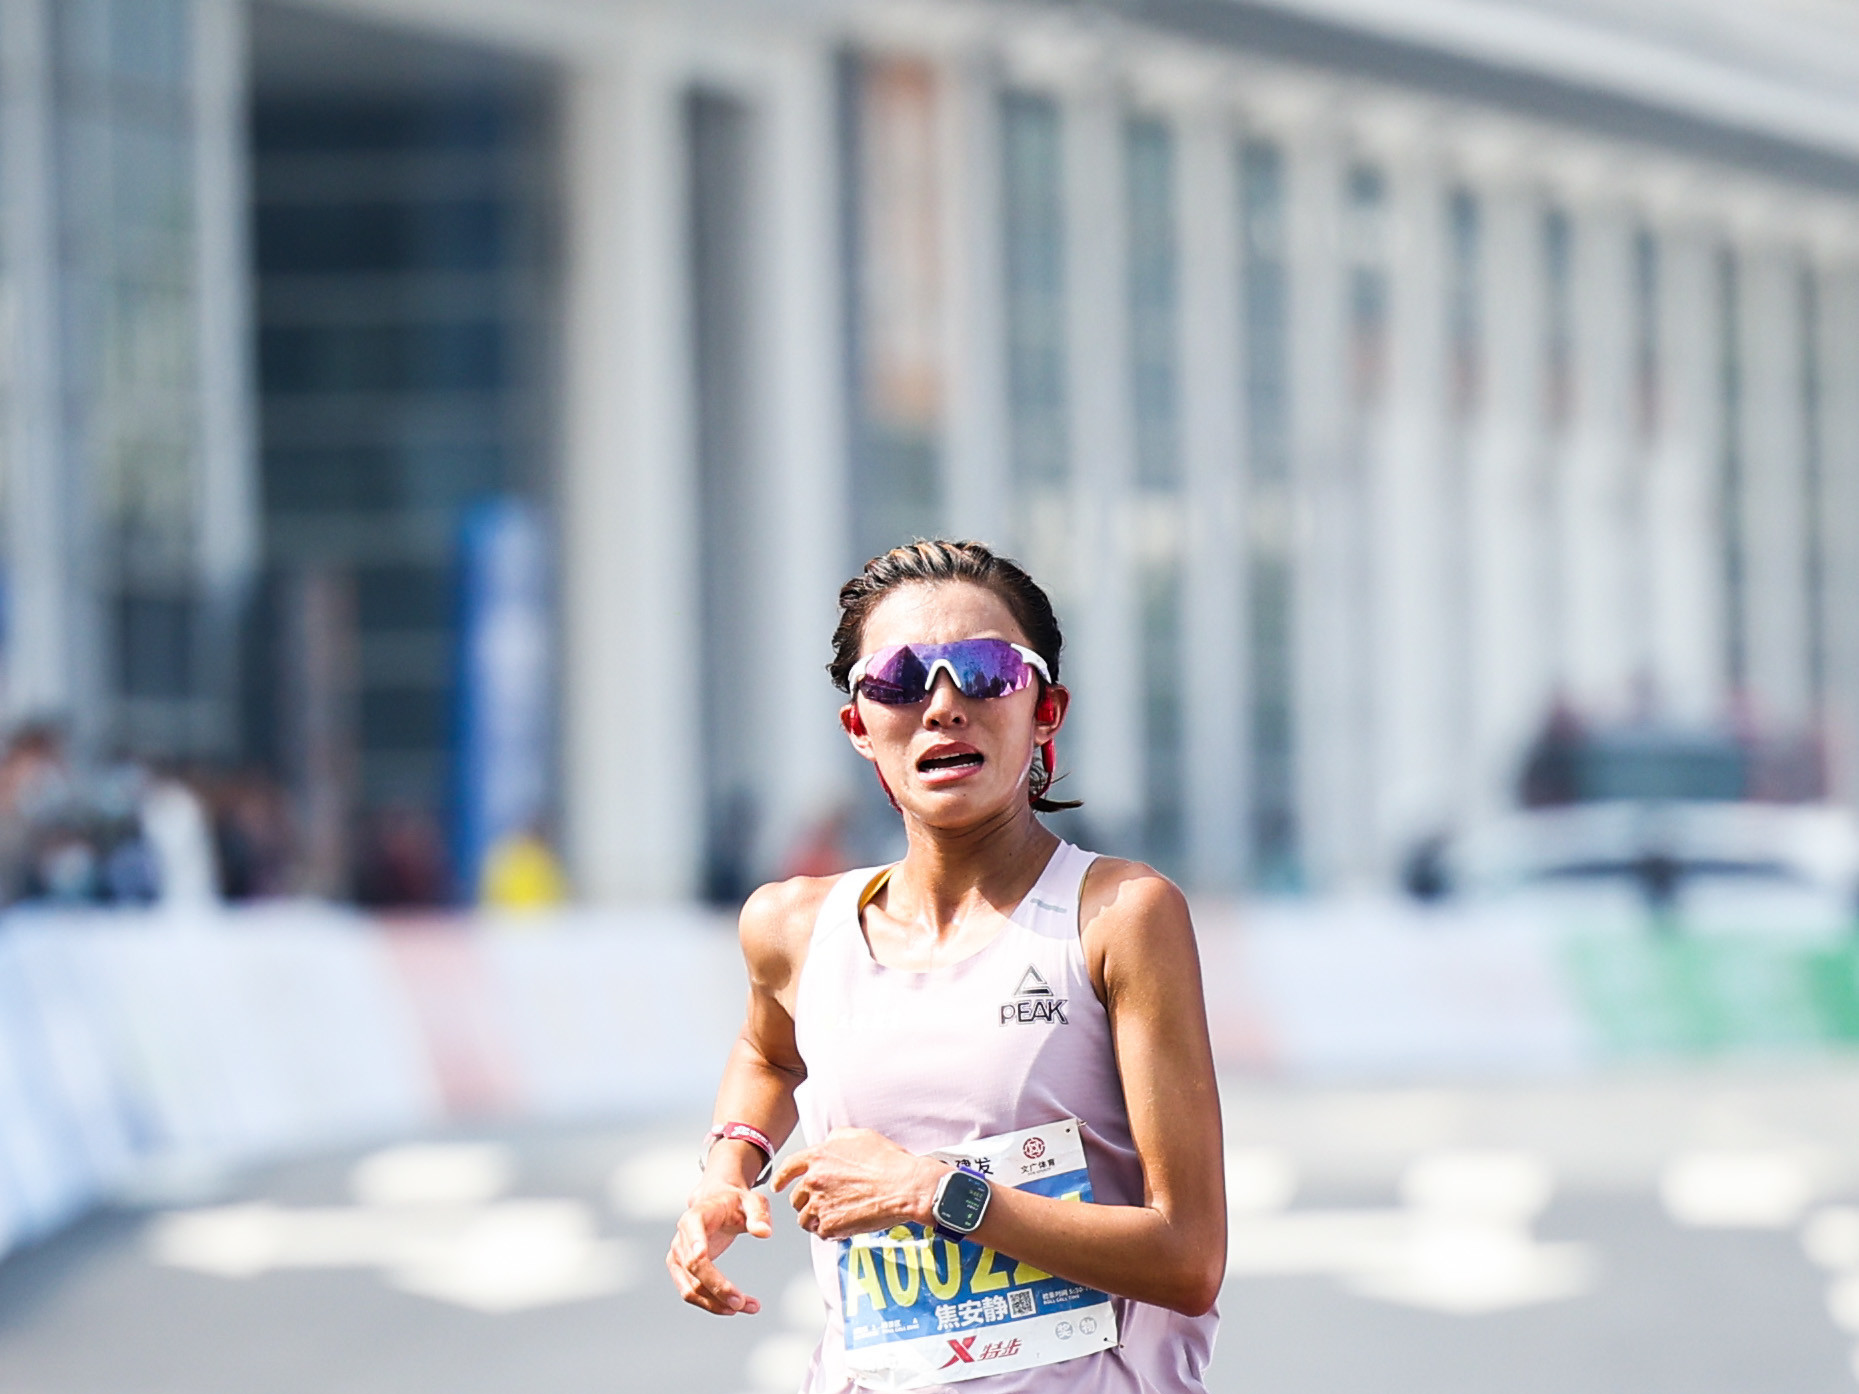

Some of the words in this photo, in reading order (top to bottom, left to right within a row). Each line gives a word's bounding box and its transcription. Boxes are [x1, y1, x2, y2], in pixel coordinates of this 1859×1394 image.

[1000, 999, 1069, 1026] PEAK
[1020, 1158, 1056, 1174] 文广体育
[935, 1295, 1009, 1331] 焦安静
[977, 1338, 1022, 1362] 特步
